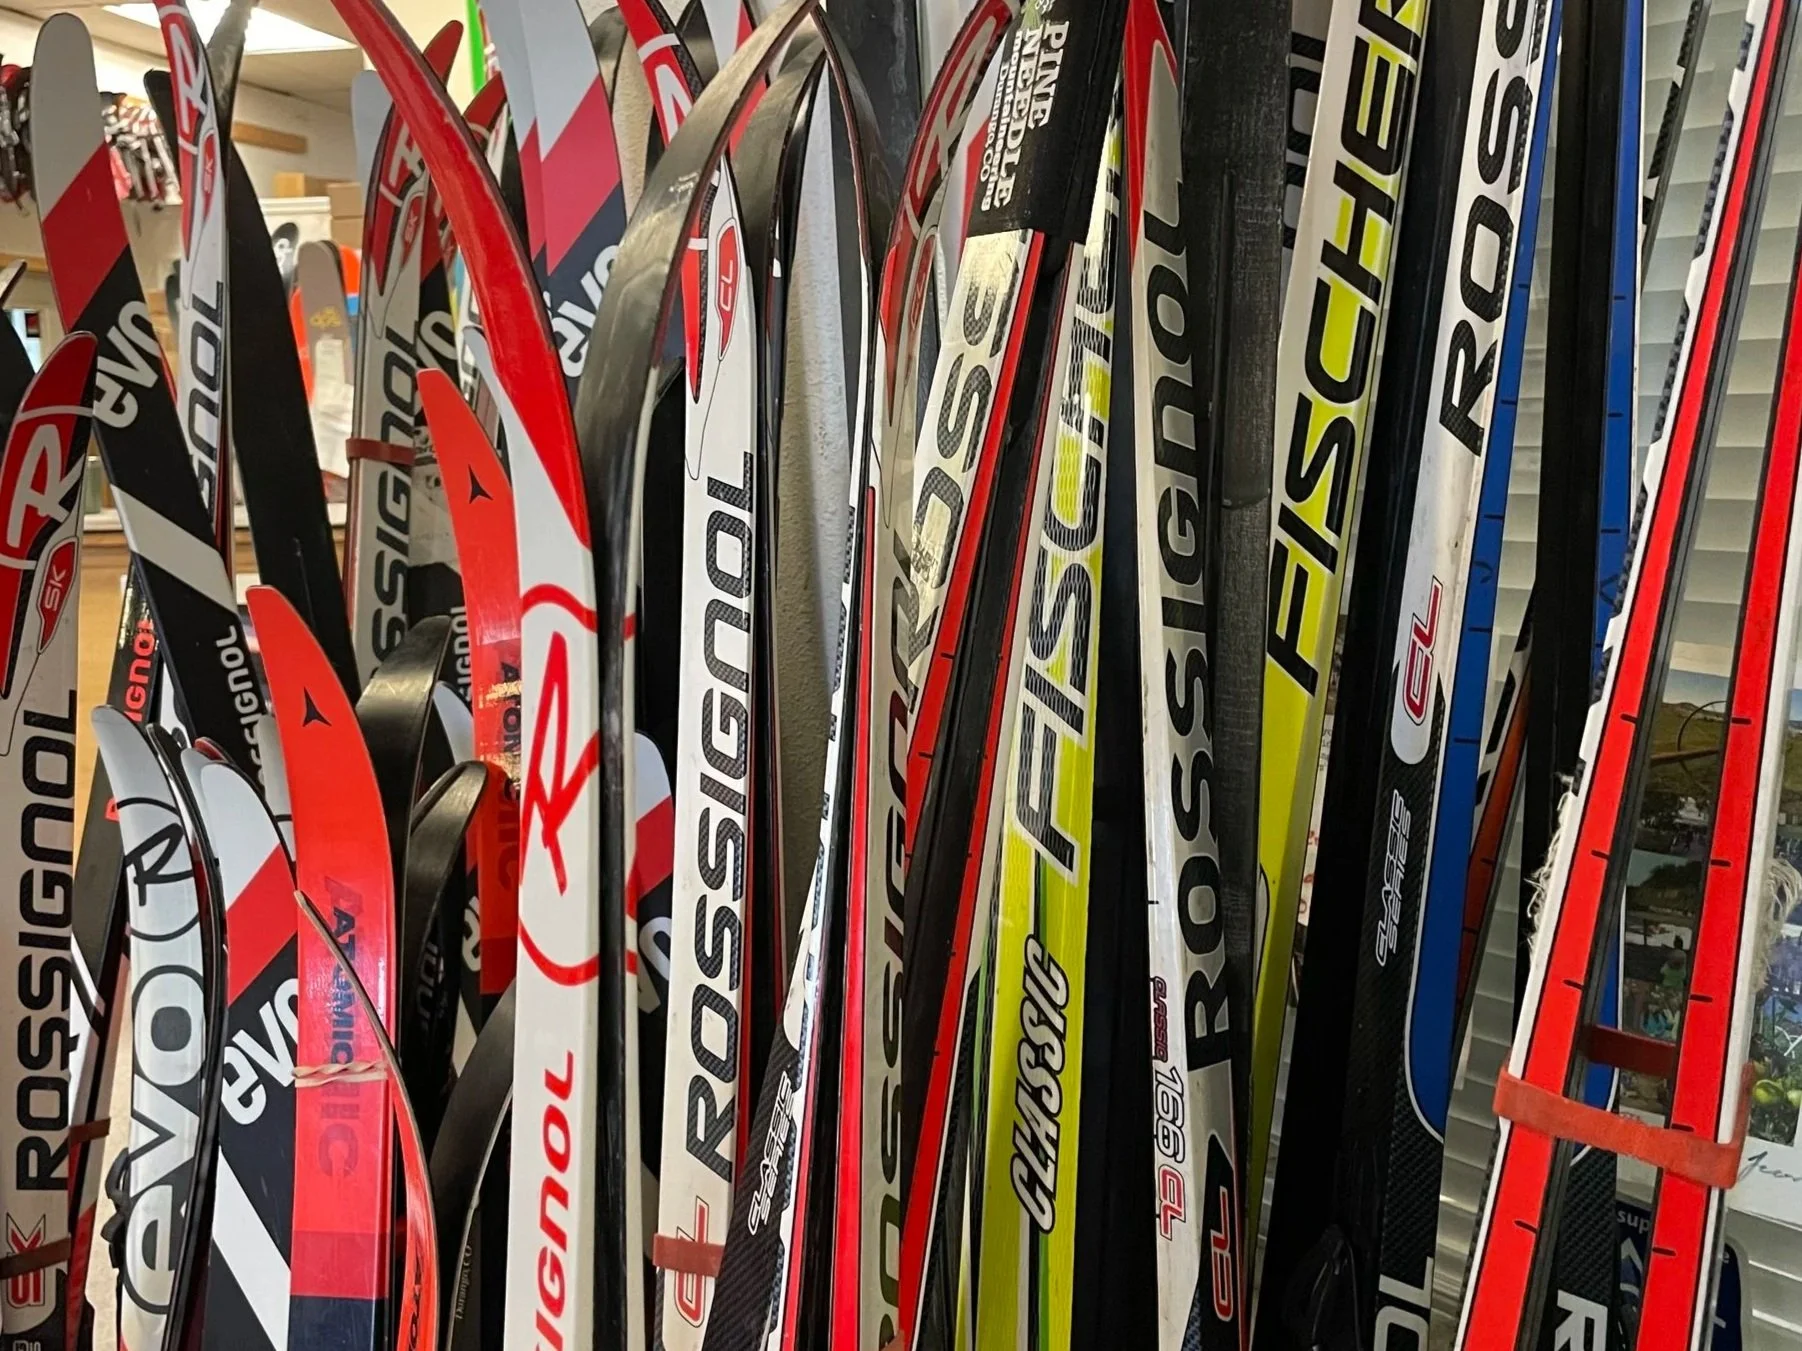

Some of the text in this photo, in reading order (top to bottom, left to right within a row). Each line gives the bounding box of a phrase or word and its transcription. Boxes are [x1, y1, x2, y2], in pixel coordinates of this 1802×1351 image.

[993, 24, 1044, 208] NEEDLE
[1028, 20, 1070, 130] PINE
[980, 146, 994, 183] CO
[717, 259, 735, 311] CL
[45, 566, 67, 611] SK
[1390, 575, 1443, 726] CL
[1376, 789, 1404, 967] CLASSIC
[122, 963, 208, 1315] evo
[748, 1071, 791, 1235] CLASSIC
[1010, 934, 1070, 1234] CLASSIC
[1153, 975, 1188, 1241] CLASSIC 166 CL
[1211, 1186, 1234, 1322] CL
